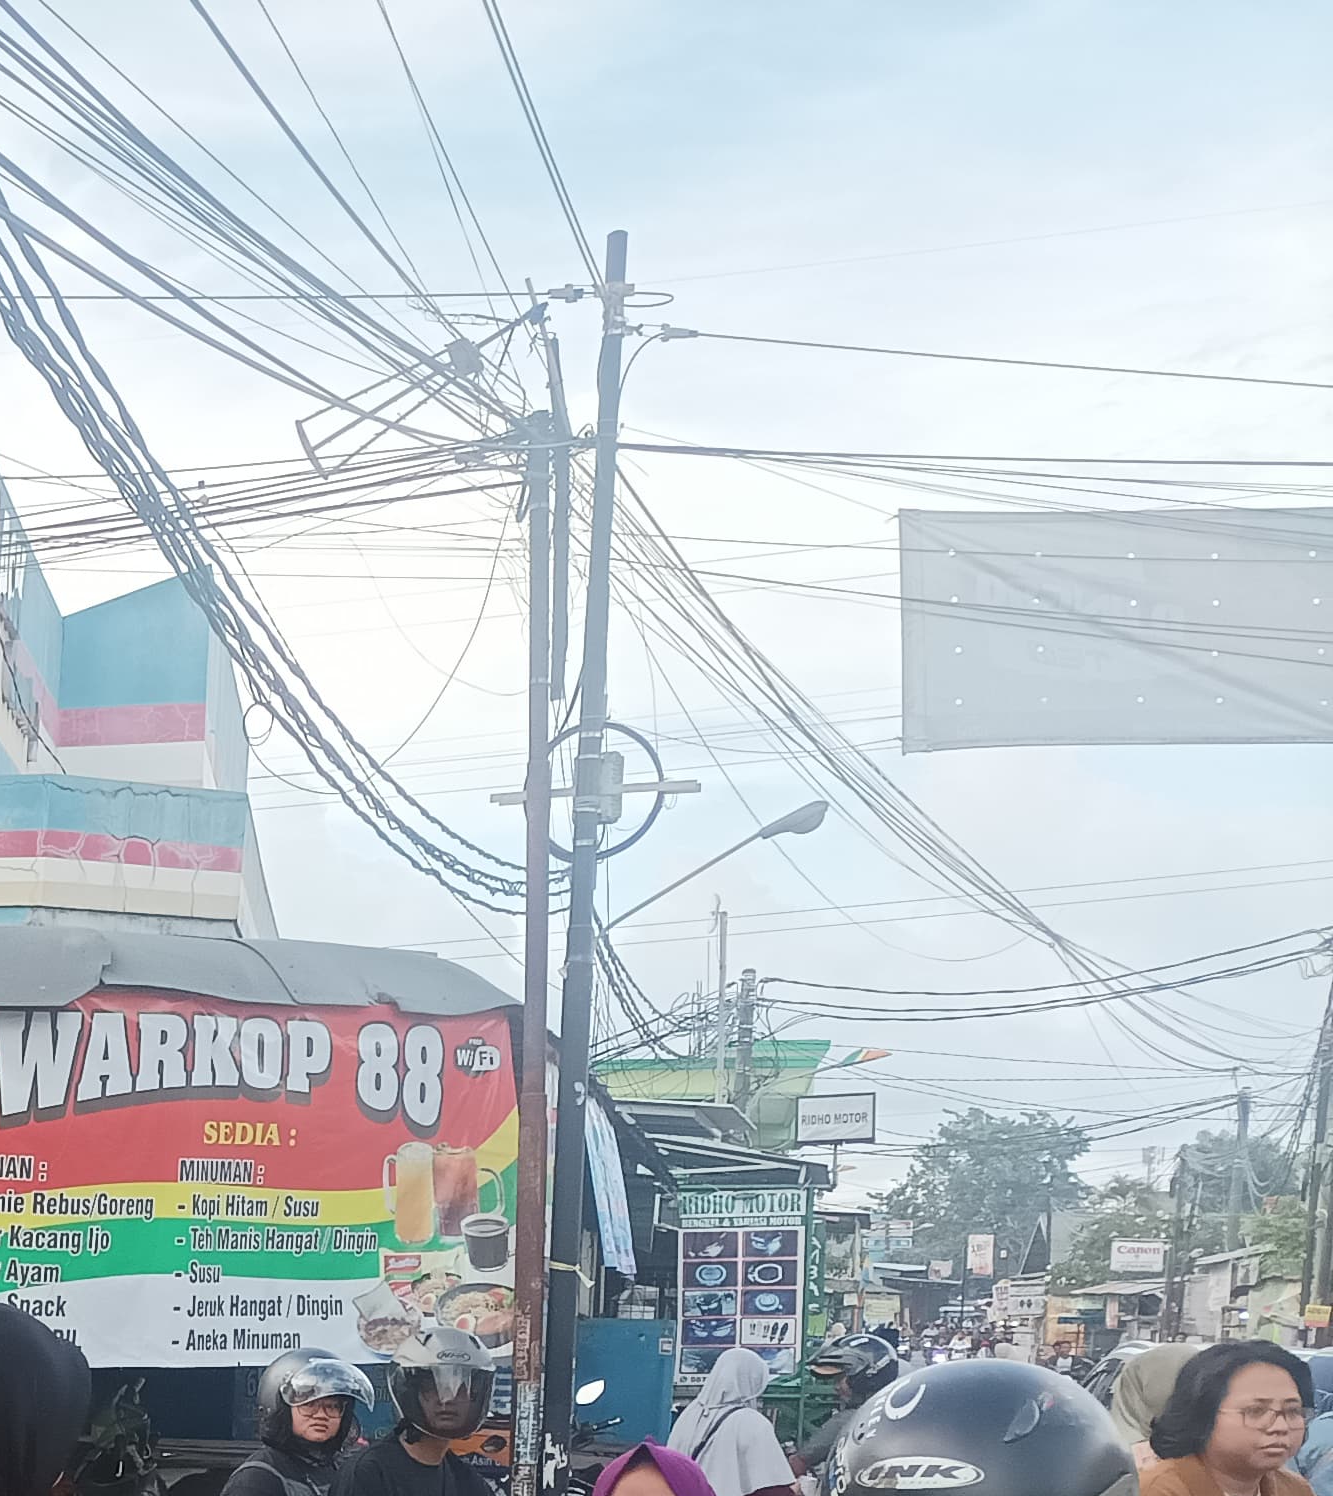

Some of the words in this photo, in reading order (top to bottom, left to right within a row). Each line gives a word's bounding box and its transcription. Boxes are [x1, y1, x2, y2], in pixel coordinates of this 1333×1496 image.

[356, 1022, 445, 1127] 88
[801, 1114, 831, 1127] RIDHO
[833, 1112, 869, 1124] MOTOR
[203, 1121, 280, 1146] SEDIA
[179, 1159, 254, 1183] MINUMAN
[32, 1193, 155, 1222] Rebus/Goreng
[192, 1194, 221, 1221] Kopi
[225, 1195, 268, 1217] Hitam
[283, 1195, 320, 1218] Susu
[681, 1192, 735, 1216] RIDHO
[741, 1192, 802, 1215] MOTOR
[9, 1225, 81, 1254] Kacang
[88, 1227, 110, 1254] Ijo
[190, 1228, 213, 1250] Teh
[218, 1228, 261, 1250] Manis
[265, 1229, 319, 1254] Hangat
[332, 1229, 378, 1254] Dingin
[1117, 1243, 1161, 1255] Canon
[6, 1259, 62, 1286] Ayam
[189, 1261, 221, 1283] Susu
[187, 1295, 225, 1318] Jeruk
[229, 1295, 283, 1321] Hangat
[296, 1294, 344, 1320] Dingin
[186, 1329, 228, 1351] Aneka
[233, 1328, 301, 1350] Minuman
[868, 1464, 966, 1480] INK
